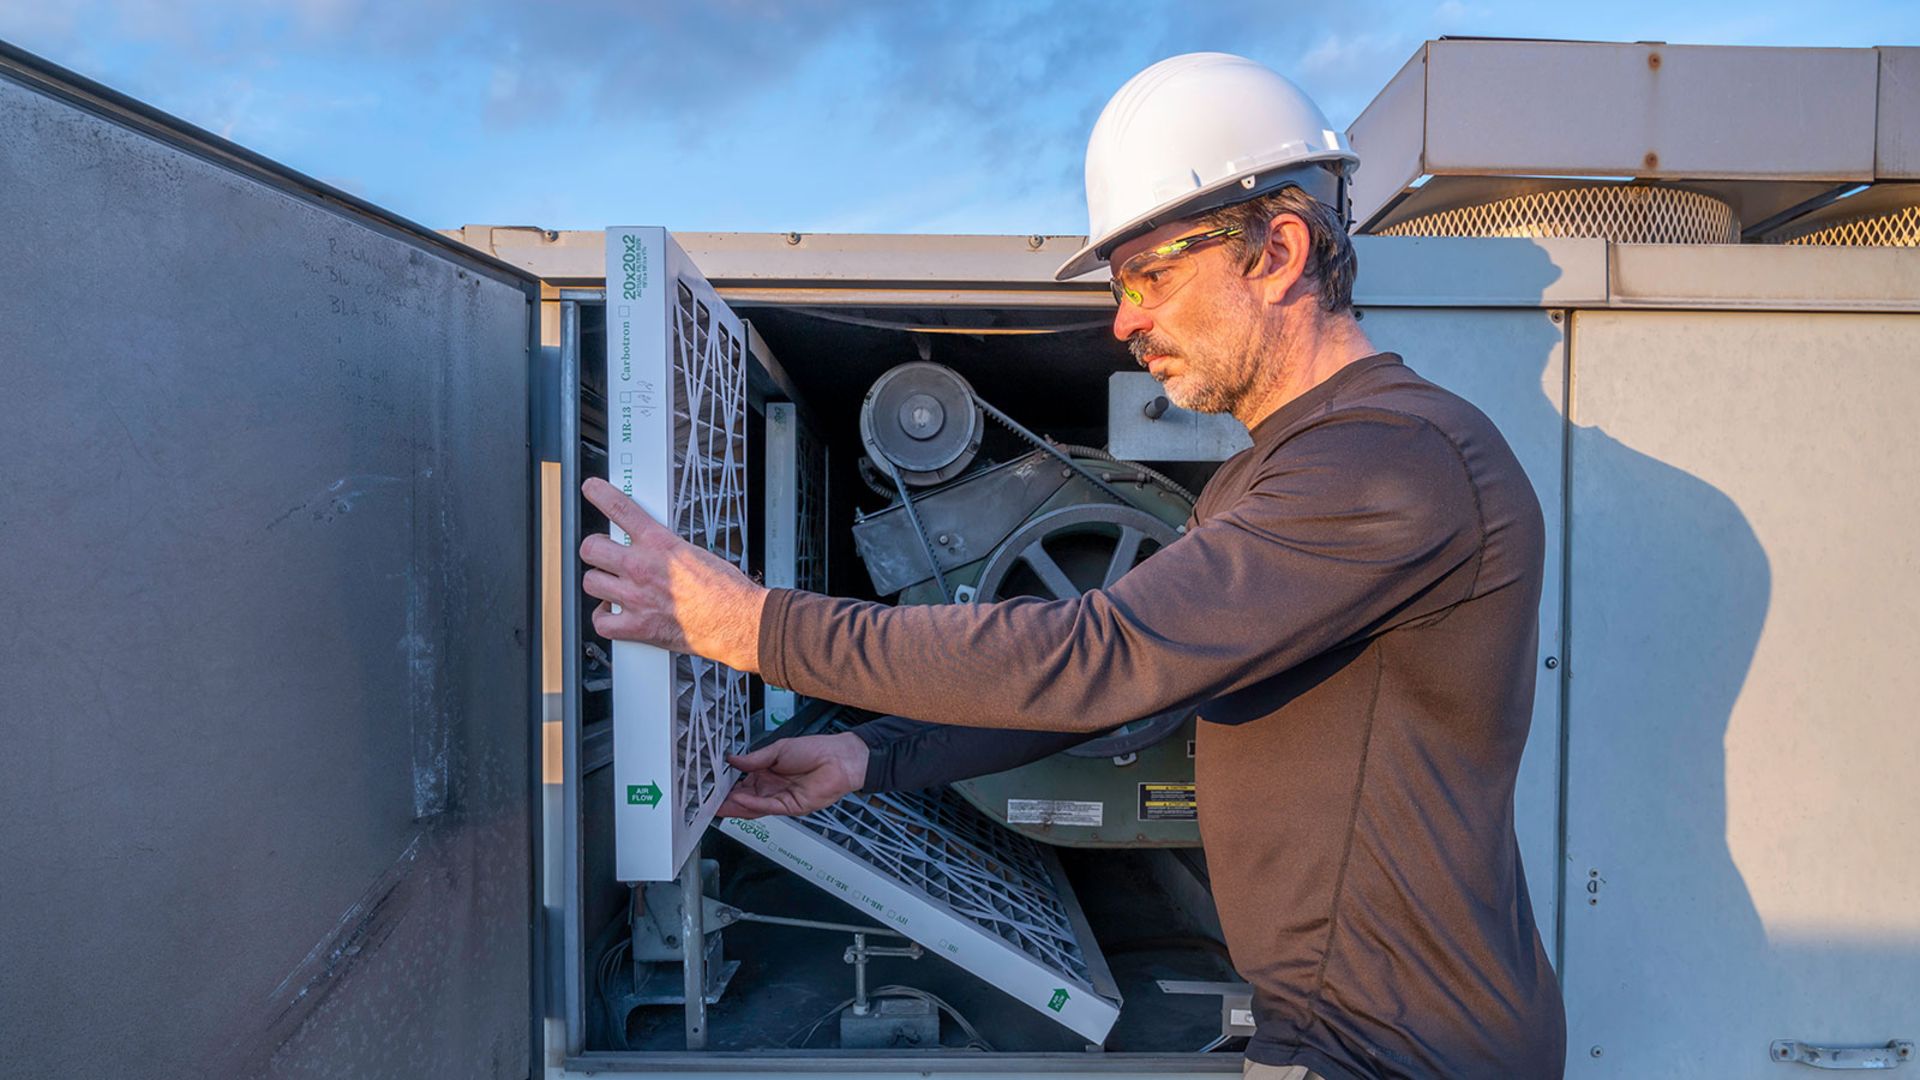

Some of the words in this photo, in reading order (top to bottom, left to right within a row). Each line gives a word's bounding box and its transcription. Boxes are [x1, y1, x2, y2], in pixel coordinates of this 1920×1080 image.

[622, 234, 636, 300] 20x20x2
[621, 321, 631, 381] Carbotron
[622, 406, 632, 443] MR-13
[631, 794, 654, 802] FLOW
[777, 847, 814, 871] Carbotron
